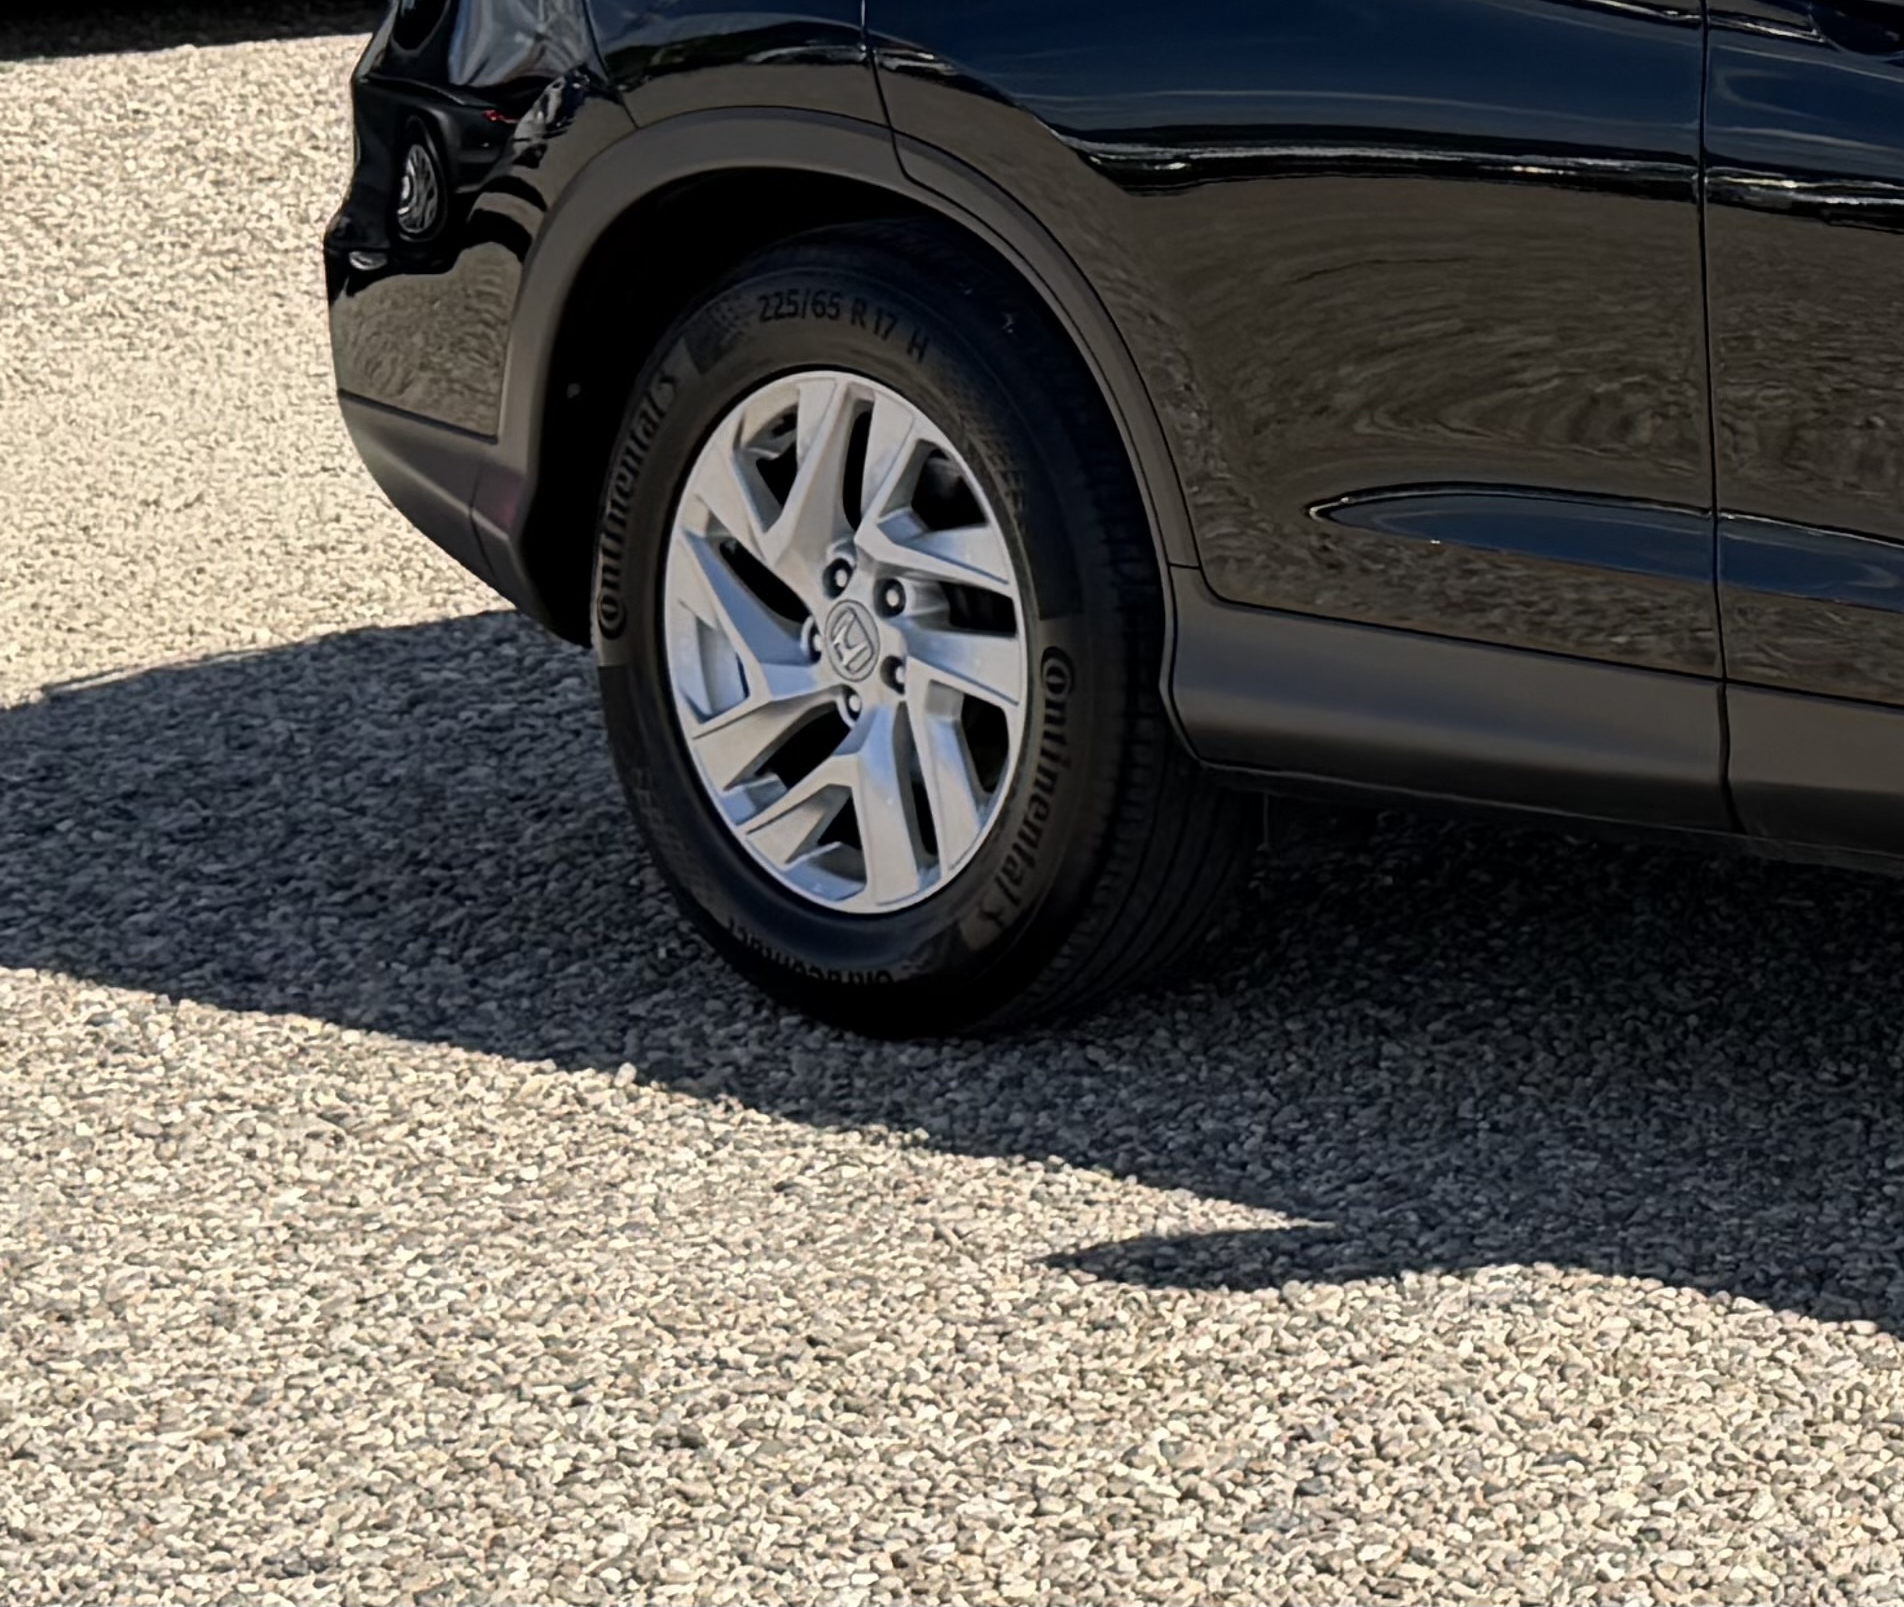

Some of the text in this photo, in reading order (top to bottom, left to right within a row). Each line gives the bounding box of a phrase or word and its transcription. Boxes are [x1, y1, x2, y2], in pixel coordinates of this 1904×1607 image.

[757, 287, 842, 322] 225/65
[906, 329, 930, 362] H
[598, 390, 667, 640] Continental
[994, 646, 1075, 905] Continental
